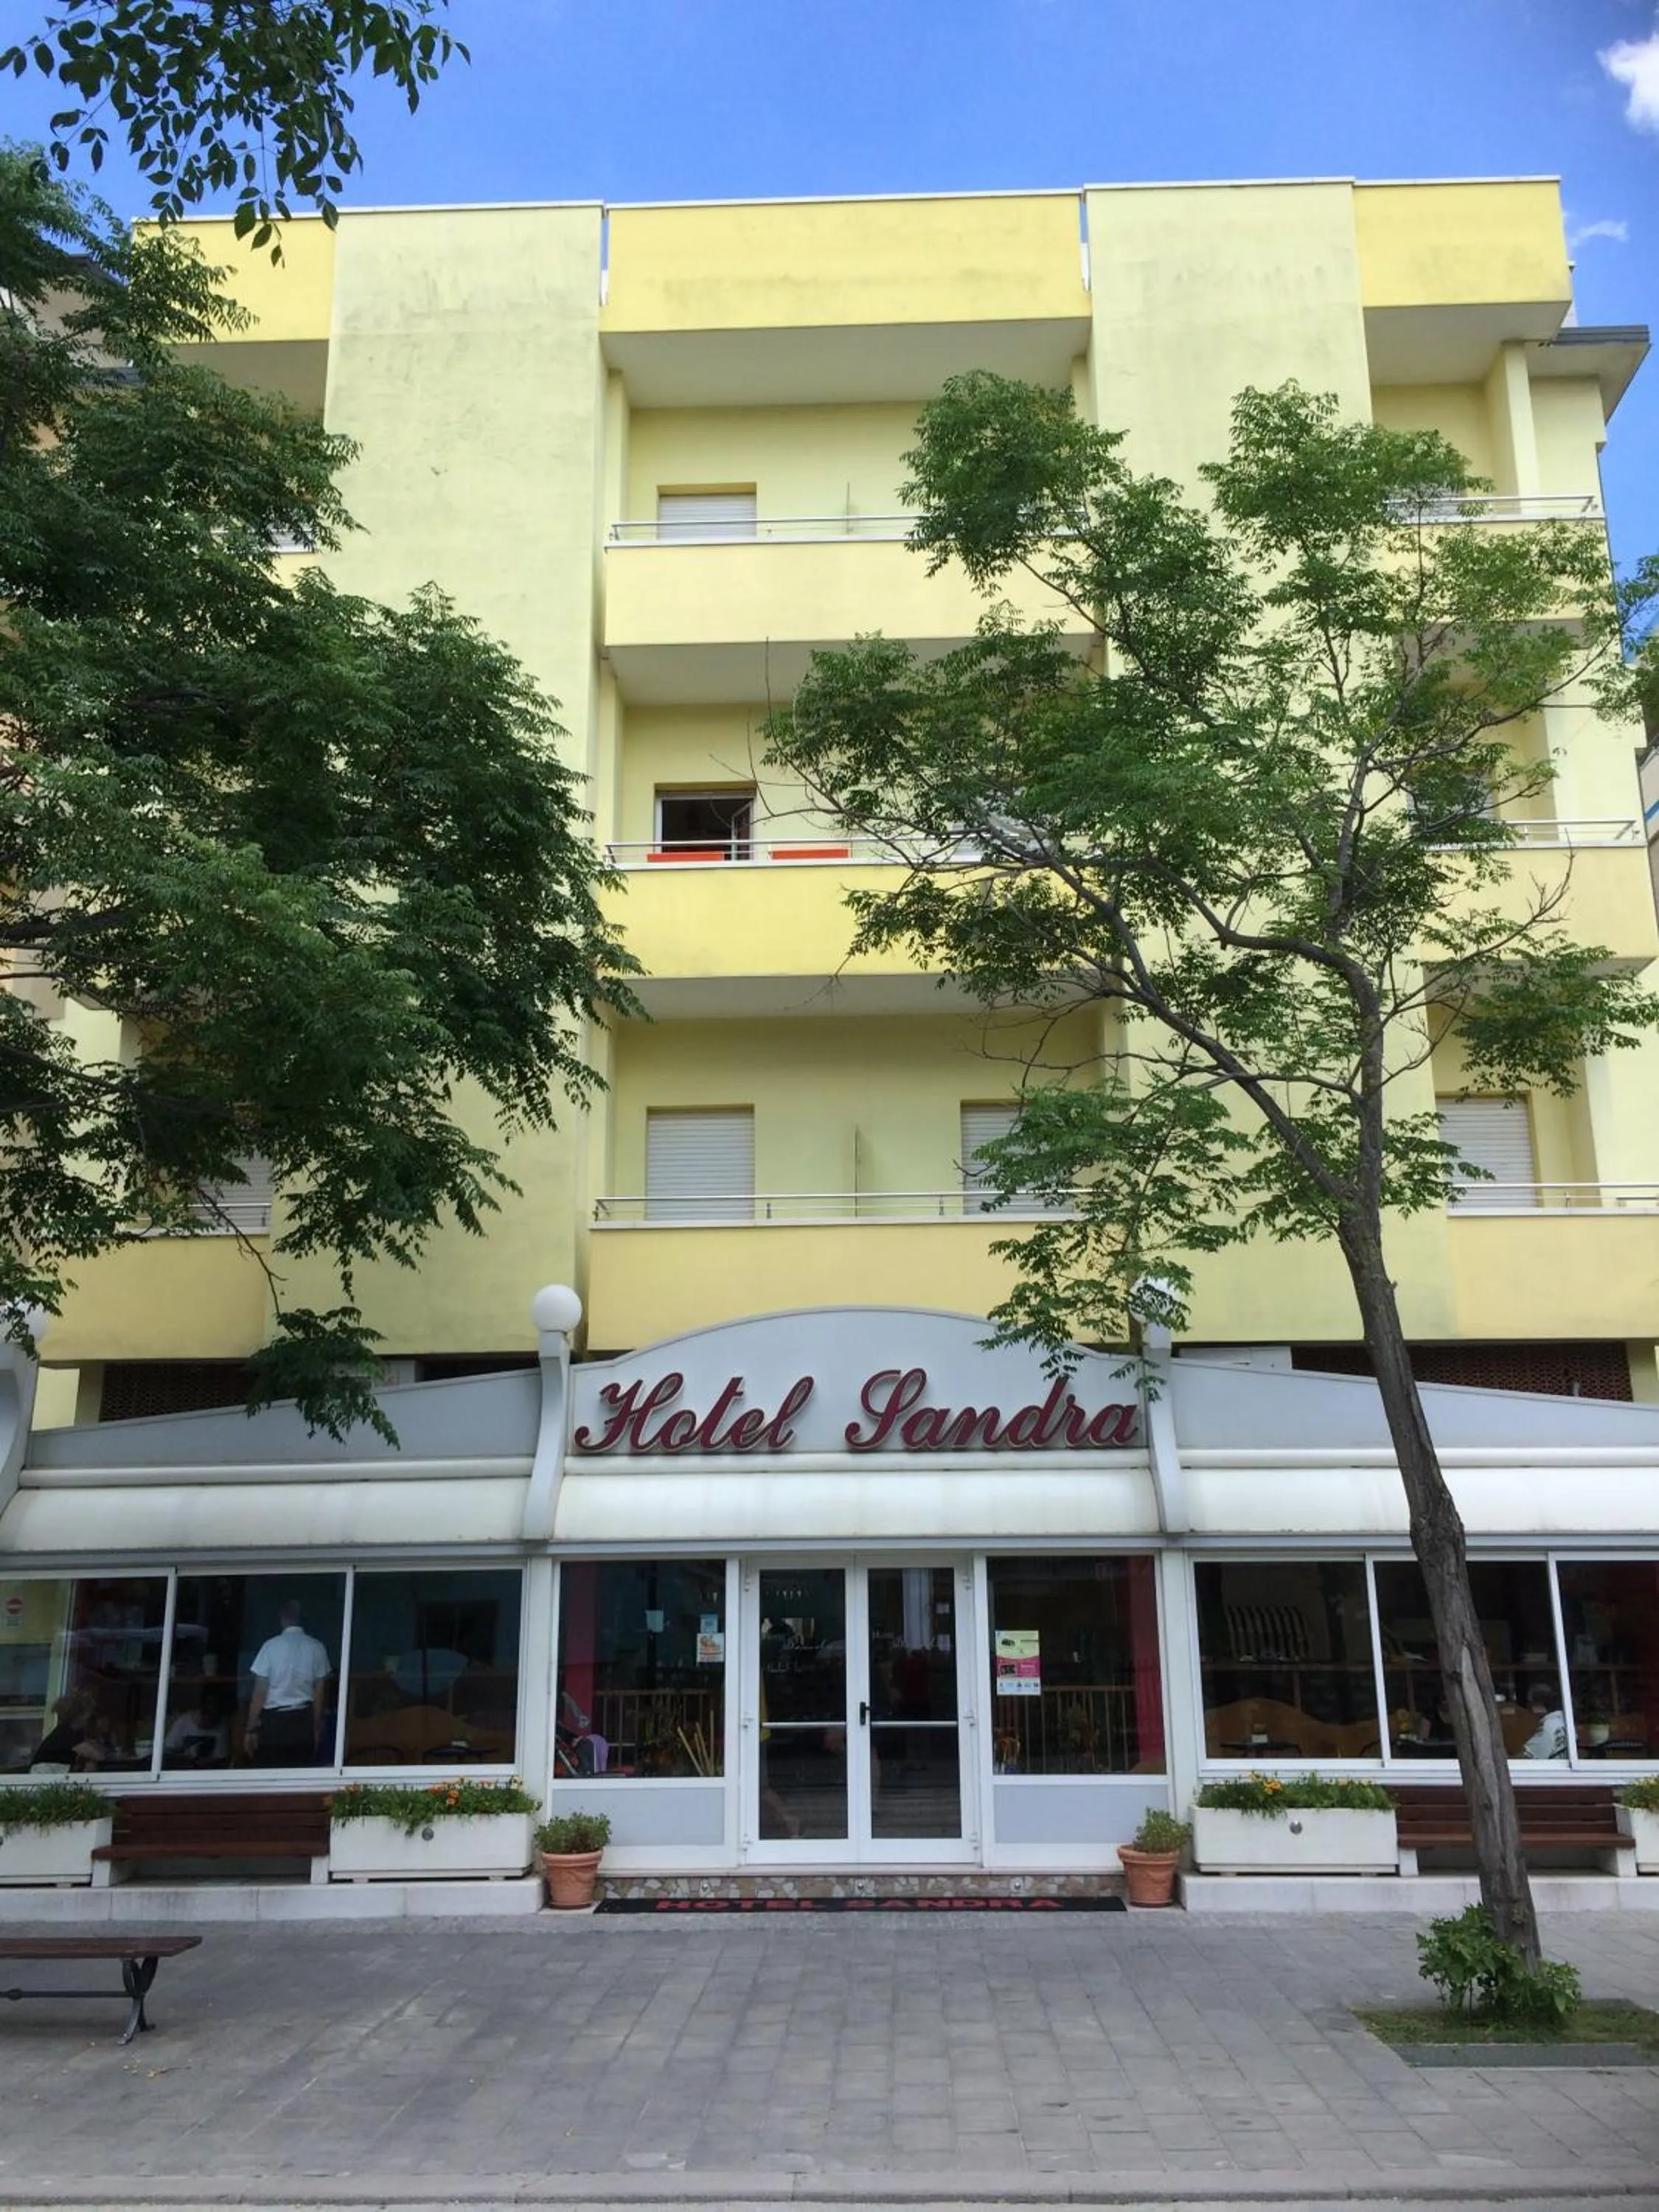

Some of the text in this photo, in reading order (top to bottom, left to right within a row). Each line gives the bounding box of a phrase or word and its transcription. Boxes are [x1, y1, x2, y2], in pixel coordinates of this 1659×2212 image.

[574, 1368, 1138, 1451] Hotel Sandra
[655, 1898, 1062, 1910] HOTEL SANDRA
